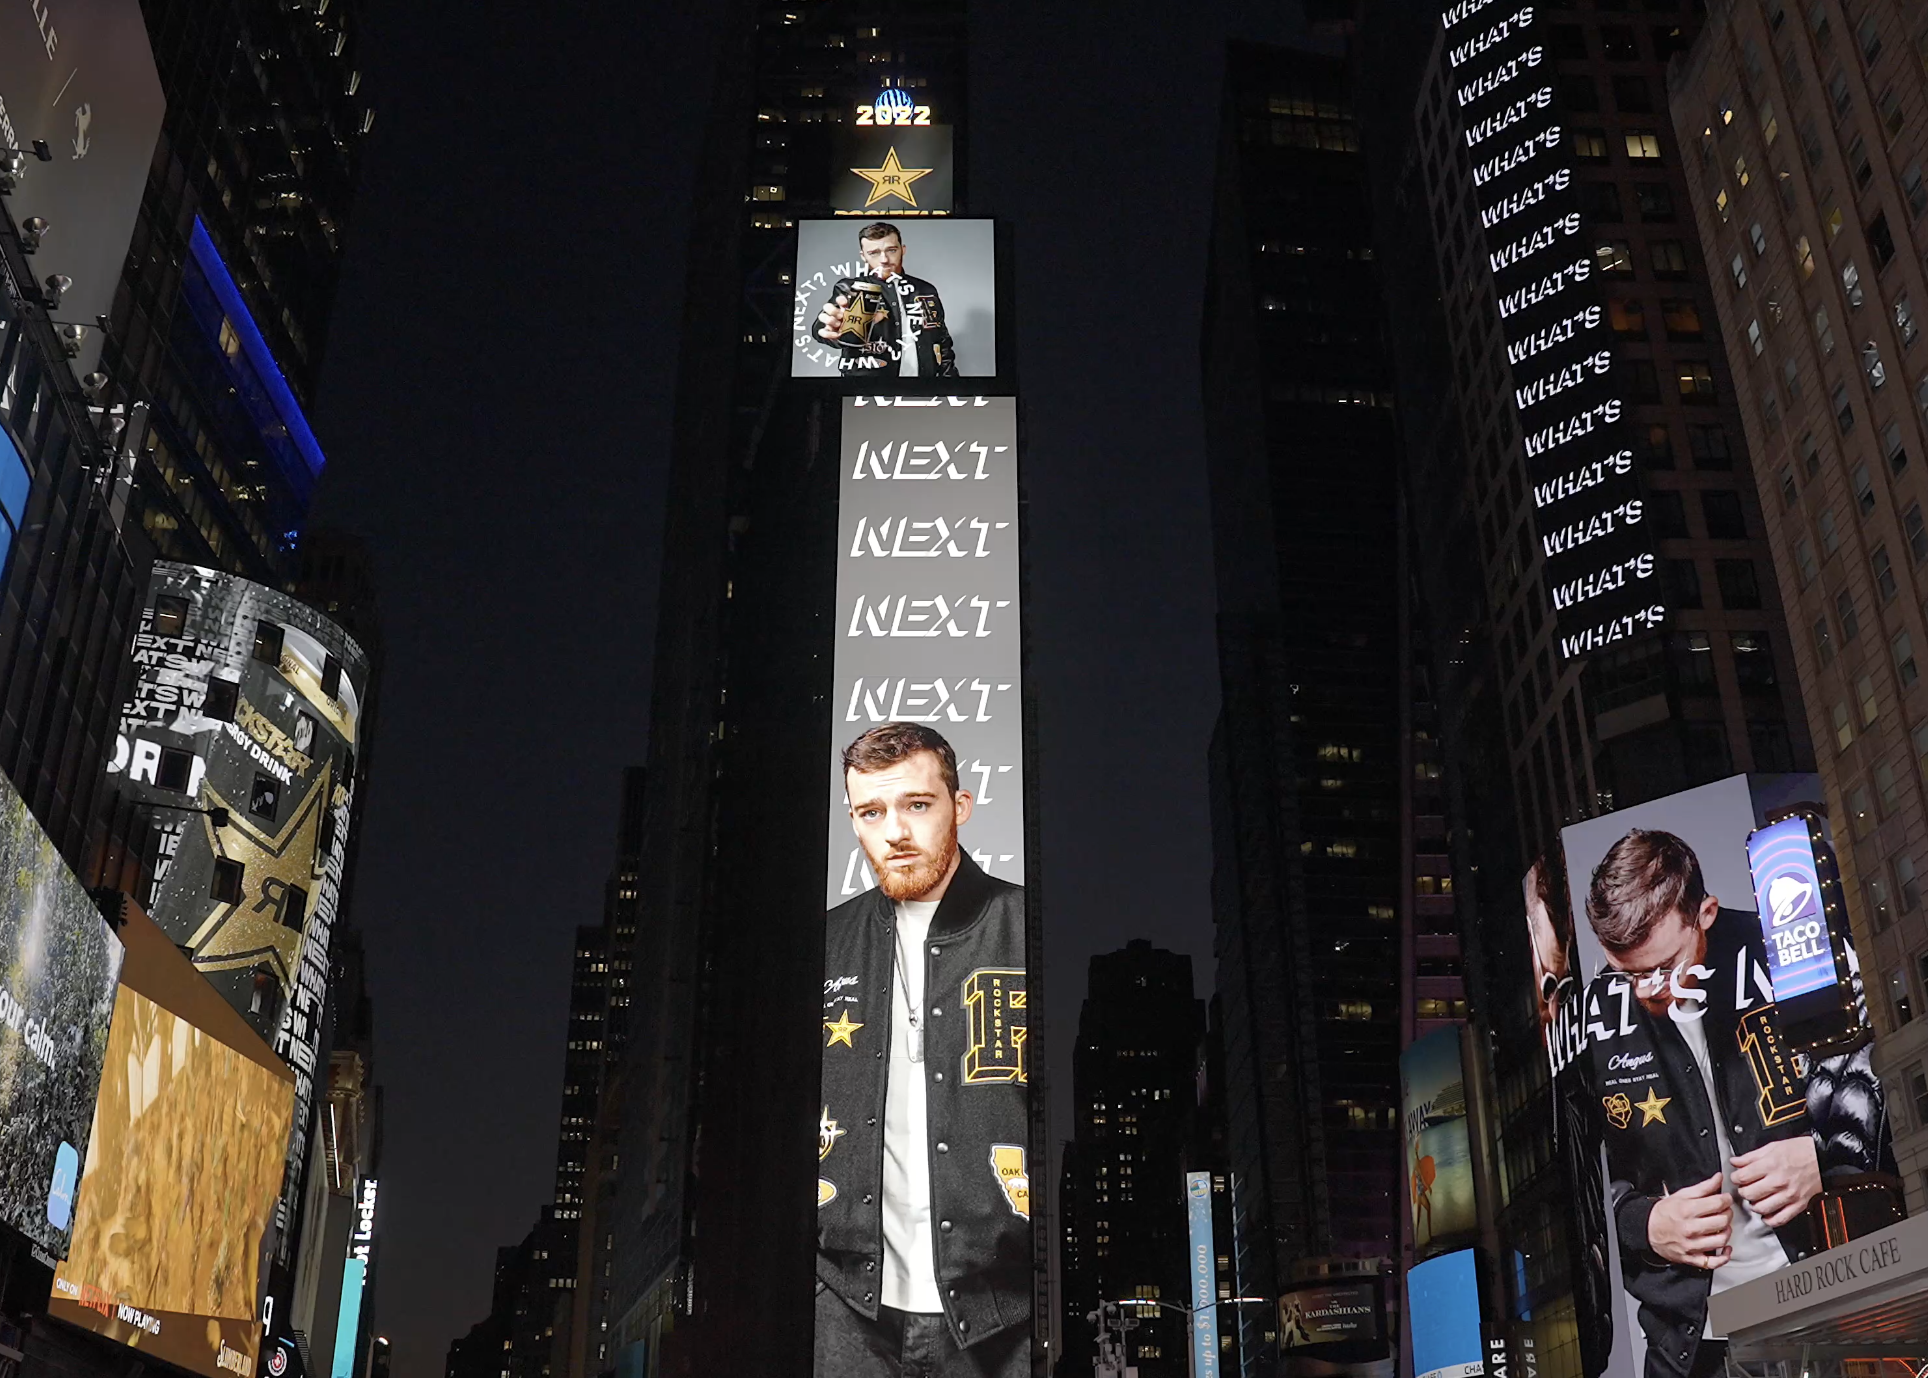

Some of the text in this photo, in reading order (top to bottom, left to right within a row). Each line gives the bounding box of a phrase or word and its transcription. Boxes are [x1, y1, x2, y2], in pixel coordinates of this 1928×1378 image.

[1450, 7, 1533, 67] WHAT'S
[1458, 46, 1543, 106] WHAT'S
[856, 105, 931, 126] 2022
[1466, 87, 1552, 147] WHAT'S
[1473, 126, 1561, 186] WHAT'S
[1482, 168, 1570, 228] WHAT'S
[1490, 212, 1581, 272] WHAT'S
[1499, 259, 1591, 318] WHAT'S
[1508, 305, 1600, 364] WHAT'S
[1516, 350, 1611, 409] WHAT'S
[1525, 399, 1621, 457] WHAT'S
[852, 440, 1008, 480] NEXT
[1534, 450, 1632, 507] WHAT'S
[850, 516, 1010, 558] NEXT
[1543, 500, 1643, 557] WHAT'S
[1553, 553, 1654, 609] WHAT'S
[847, 594, 1011, 638] NEXT
[1562, 605, 1665, 658] WHAT'S
[845, 677, 1012, 723] NEXT
[249, 743, 294, 786] DRINK
[1771, 921, 1821, 950] TACO
[1778, 939, 1826, 967] BELL
[24, 1016, 56, 1072] calm.
[993, 978, 1003, 1059] ROCKSTAR
[1608, 1051, 1654, 1071] Angus
[1759, 1015, 1794, 1096] ROCKSTAR
[1001, 1167, 1021, 1177] OAK
[353, 1179, 379, 1241] Locker
[1774, 1237, 1901, 1304] HARD ROCK CAFE
[117, 1302, 134, 1324] NOW
[1305, 1306, 1371, 1319] KARDASHIANS
